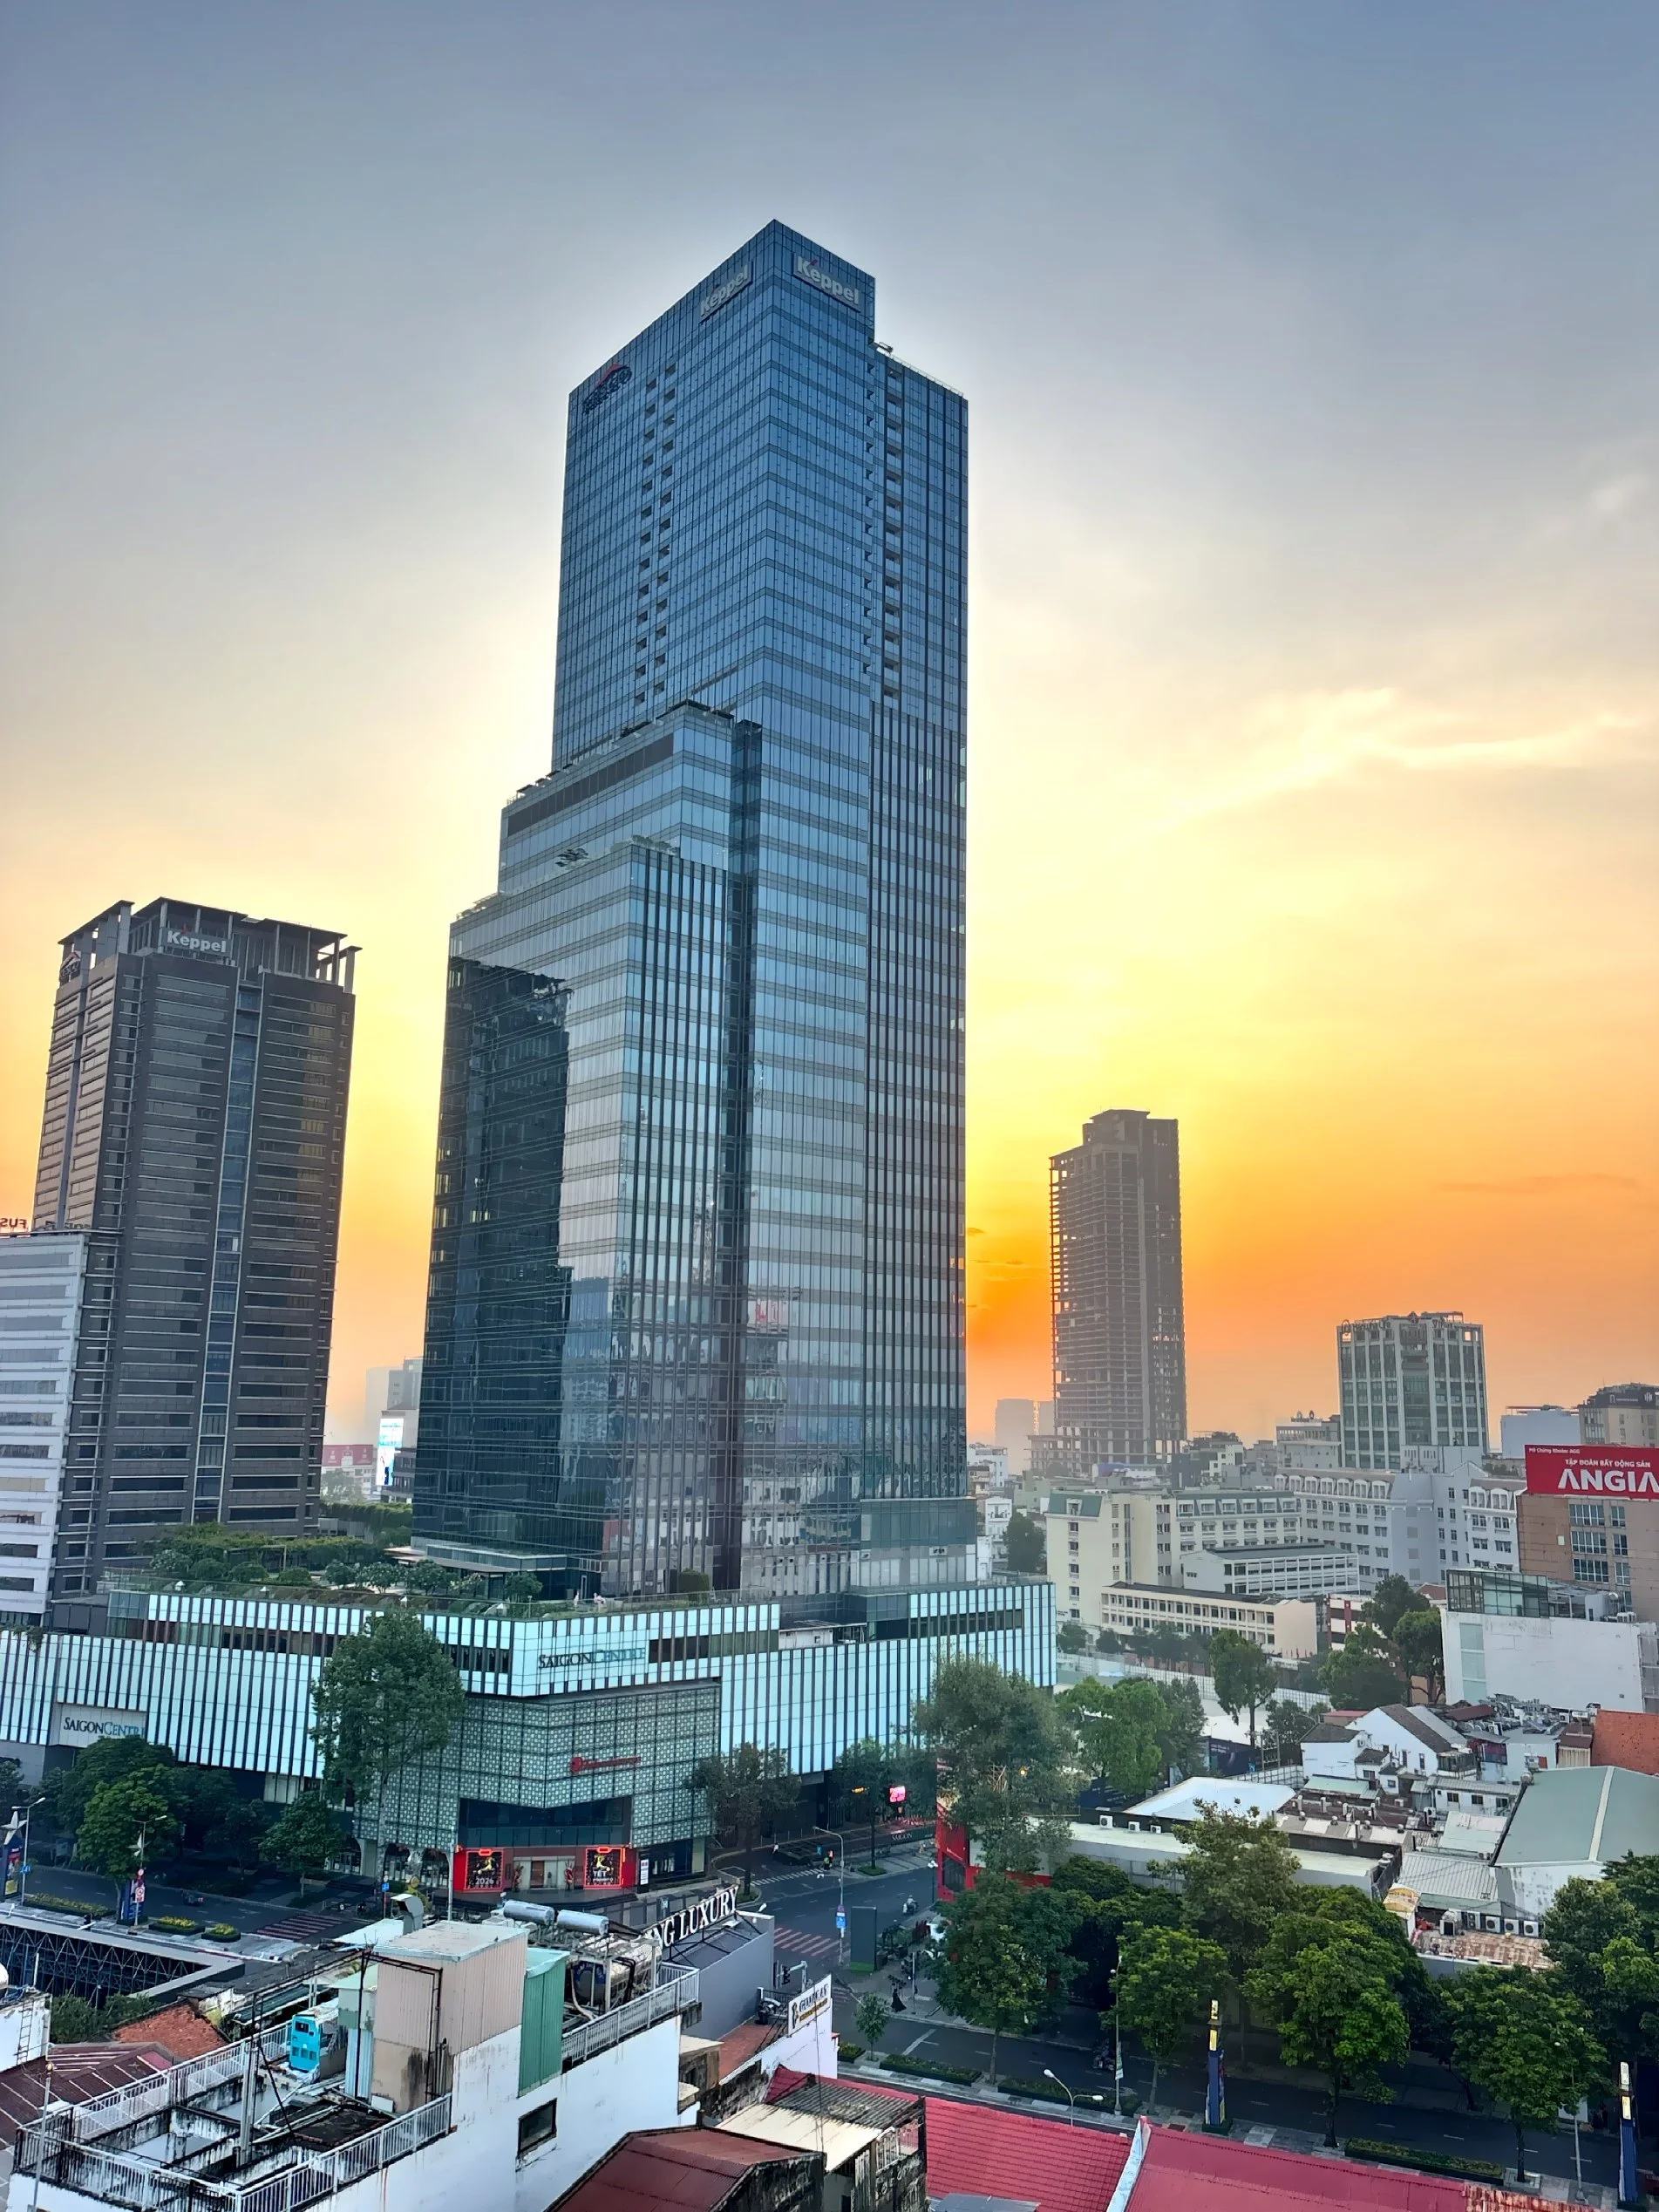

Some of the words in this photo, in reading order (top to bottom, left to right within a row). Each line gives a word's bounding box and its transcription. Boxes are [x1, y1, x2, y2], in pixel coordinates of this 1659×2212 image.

[700, 264, 749, 316] Keppel
[797, 255, 860, 305] Keppel
[167, 929, 227, 953] Keppel
[679, 1884, 739, 1941] LUXURY
